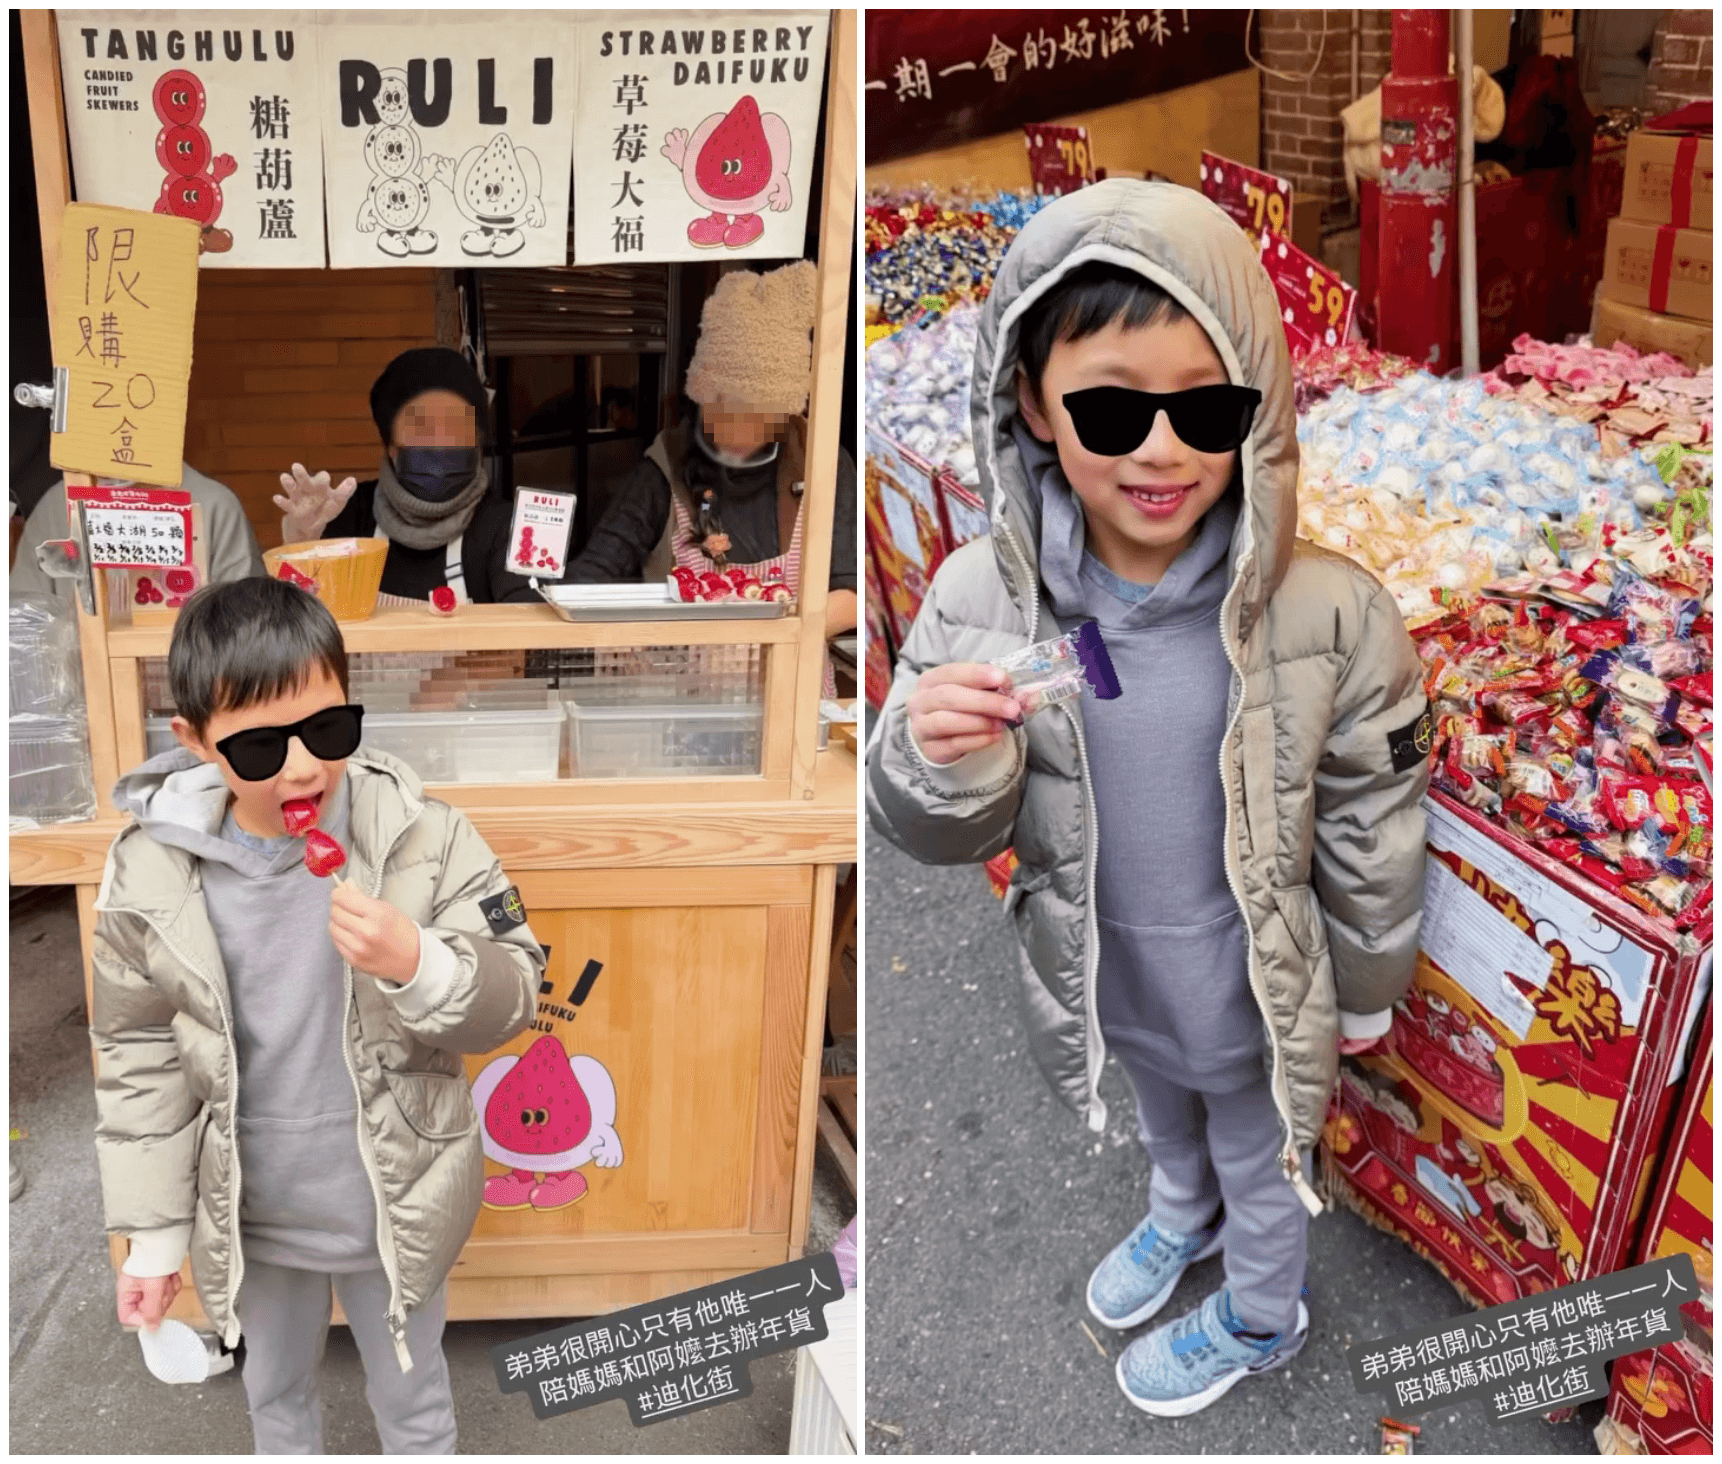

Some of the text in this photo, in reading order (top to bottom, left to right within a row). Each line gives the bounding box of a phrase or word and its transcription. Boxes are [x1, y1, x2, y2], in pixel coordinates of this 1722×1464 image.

[81, 28, 295, 62] TANGHULU
[600, 26, 813, 57] STRAWBERRY
[84, 69, 134, 83] CANDIED
[673, 57, 810, 86] DAIFUKU
[86, 84, 119, 98] FRUIT
[86, 99, 140, 112] SKEWERS
[339, 57, 553, 128] RULI
[249, 94, 298, 242] 糖葫蘆
[610, 74, 649, 253] 草莓大福
[1062, 140, 1088, 178] 79
[1247, 186, 1285, 237] 79
[1307, 271, 1344, 327] 59
[533, 495, 560, 507] RULI
[538, 1002, 577, 1022] IFUKU
